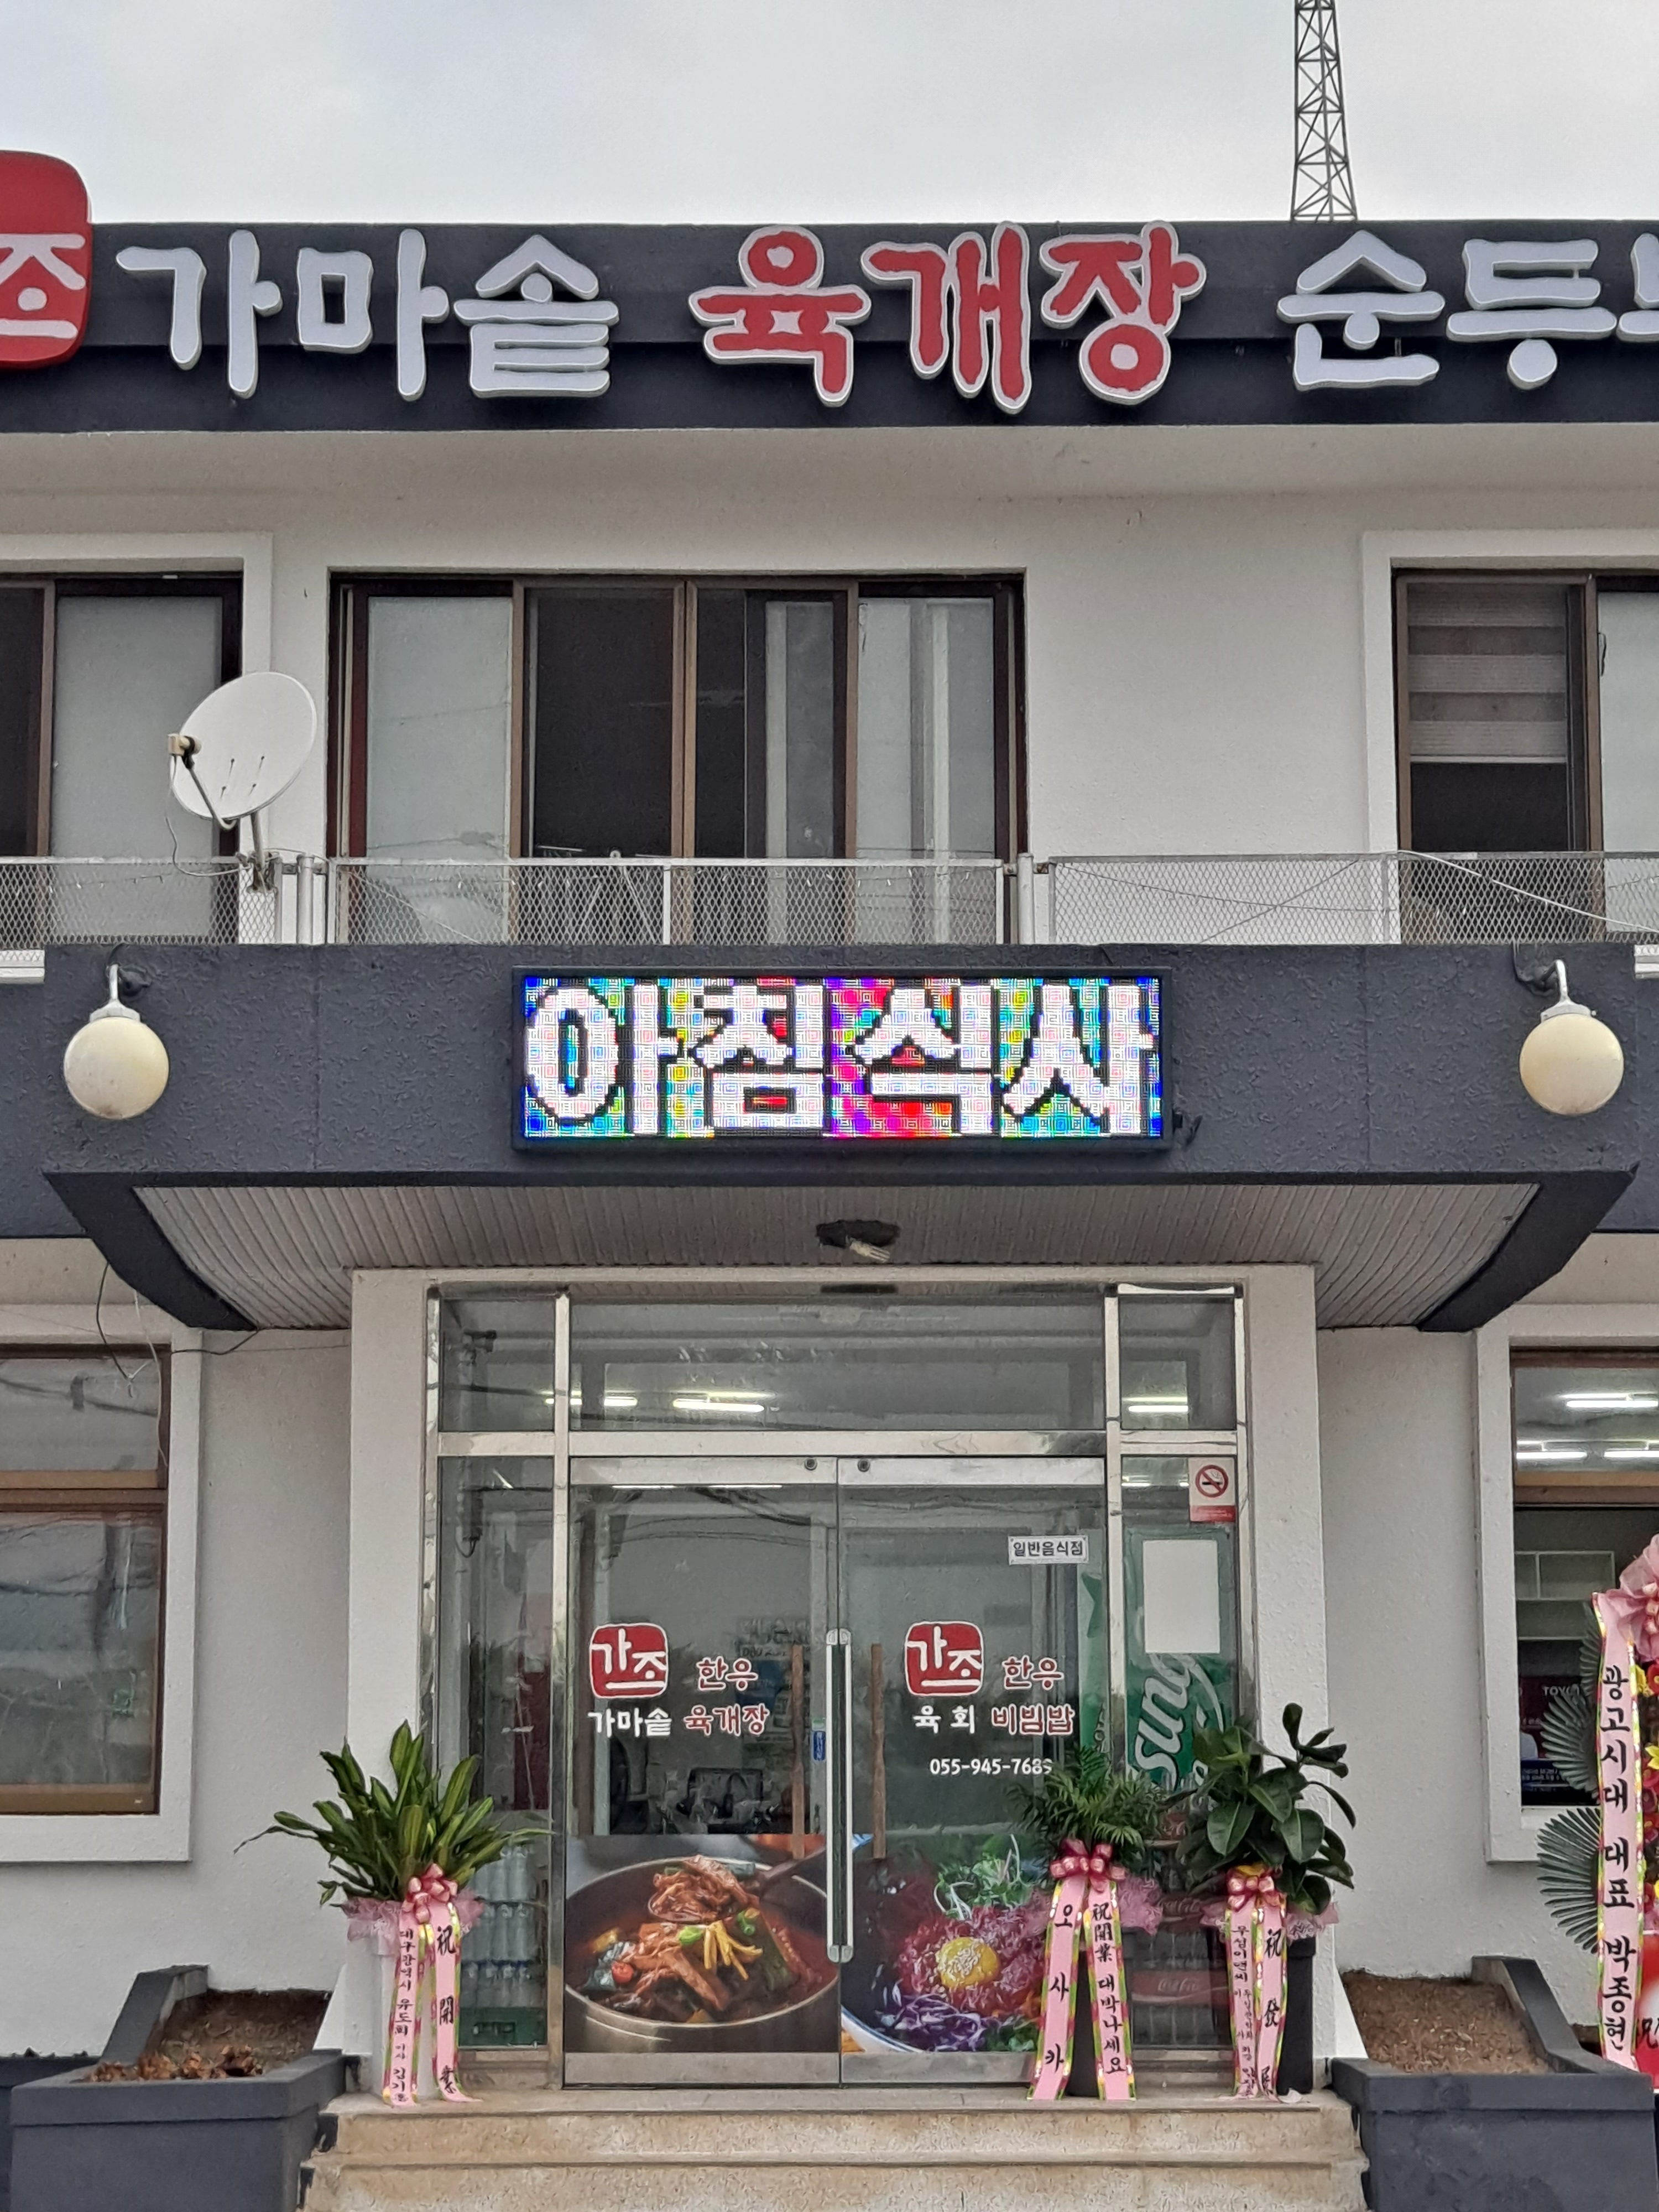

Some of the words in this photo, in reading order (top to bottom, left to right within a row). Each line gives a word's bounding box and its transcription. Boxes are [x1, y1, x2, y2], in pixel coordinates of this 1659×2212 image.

[116, 228, 619, 402] 가마솥
[688, 221, 1206, 415] 육개장
[1276, 229, 1659, 391] 순두
[524, 982, 1155, 1137] 아침식사
[1013, 1541, 1083, 1557] 일반음식점
[592, 1629, 666, 1689] 가조
[906, 1625, 983, 1687] 가조
[587, 1707, 672, 1739] 가마솥
[683, 1703, 770, 1737] 육개장
[991, 1703, 1076, 1735] 비빔밥
[1600, 1665, 1631, 1814] 광고시대
[1604, 1836, 1635, 1909] 대표
[1045, 1903, 1073, 2073] 오사카
[1098, 1973, 1126, 2075] 대박나세요
[1603, 1935, 1637, 2052] 박종현
